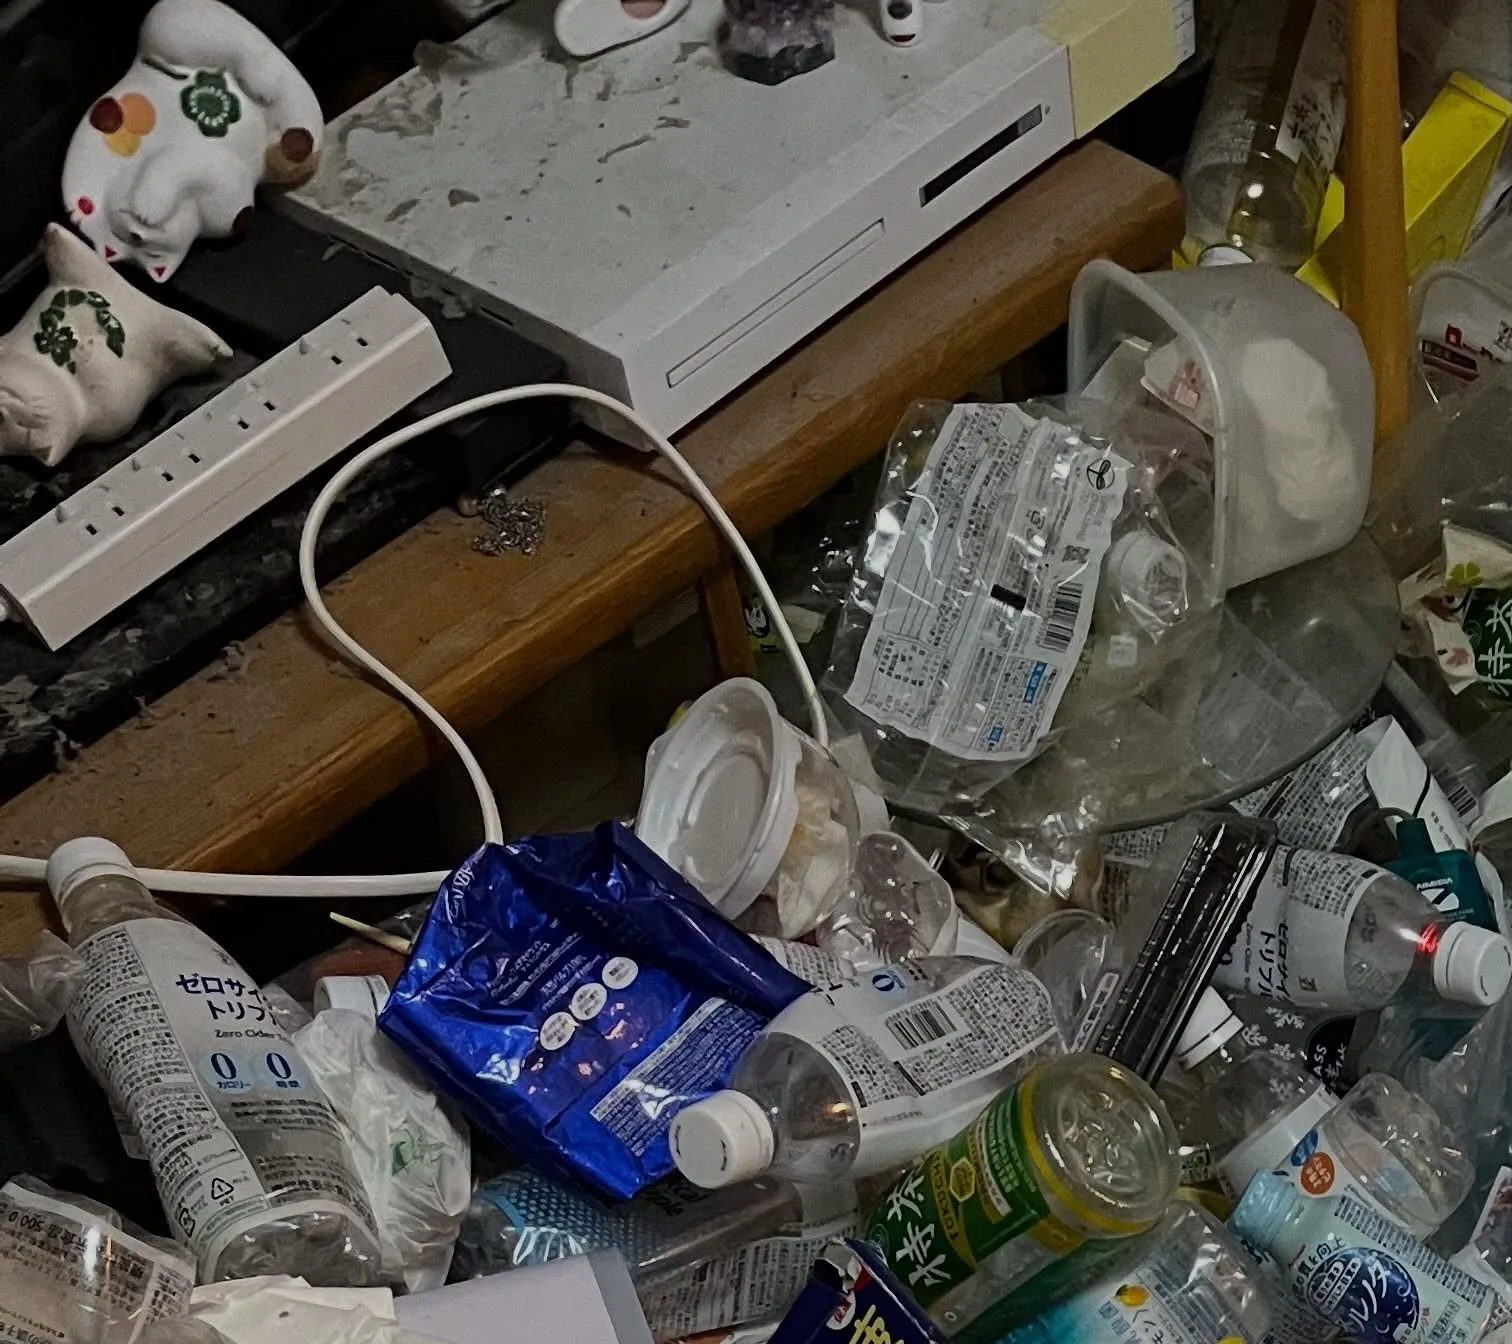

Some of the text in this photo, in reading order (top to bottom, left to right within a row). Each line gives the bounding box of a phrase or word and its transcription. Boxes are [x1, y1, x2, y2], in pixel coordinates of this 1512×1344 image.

[210, 1051, 238, 1081] 0
[265, 1051, 293, 1081] 0
[886, 1170, 952, 1288] 特茶
